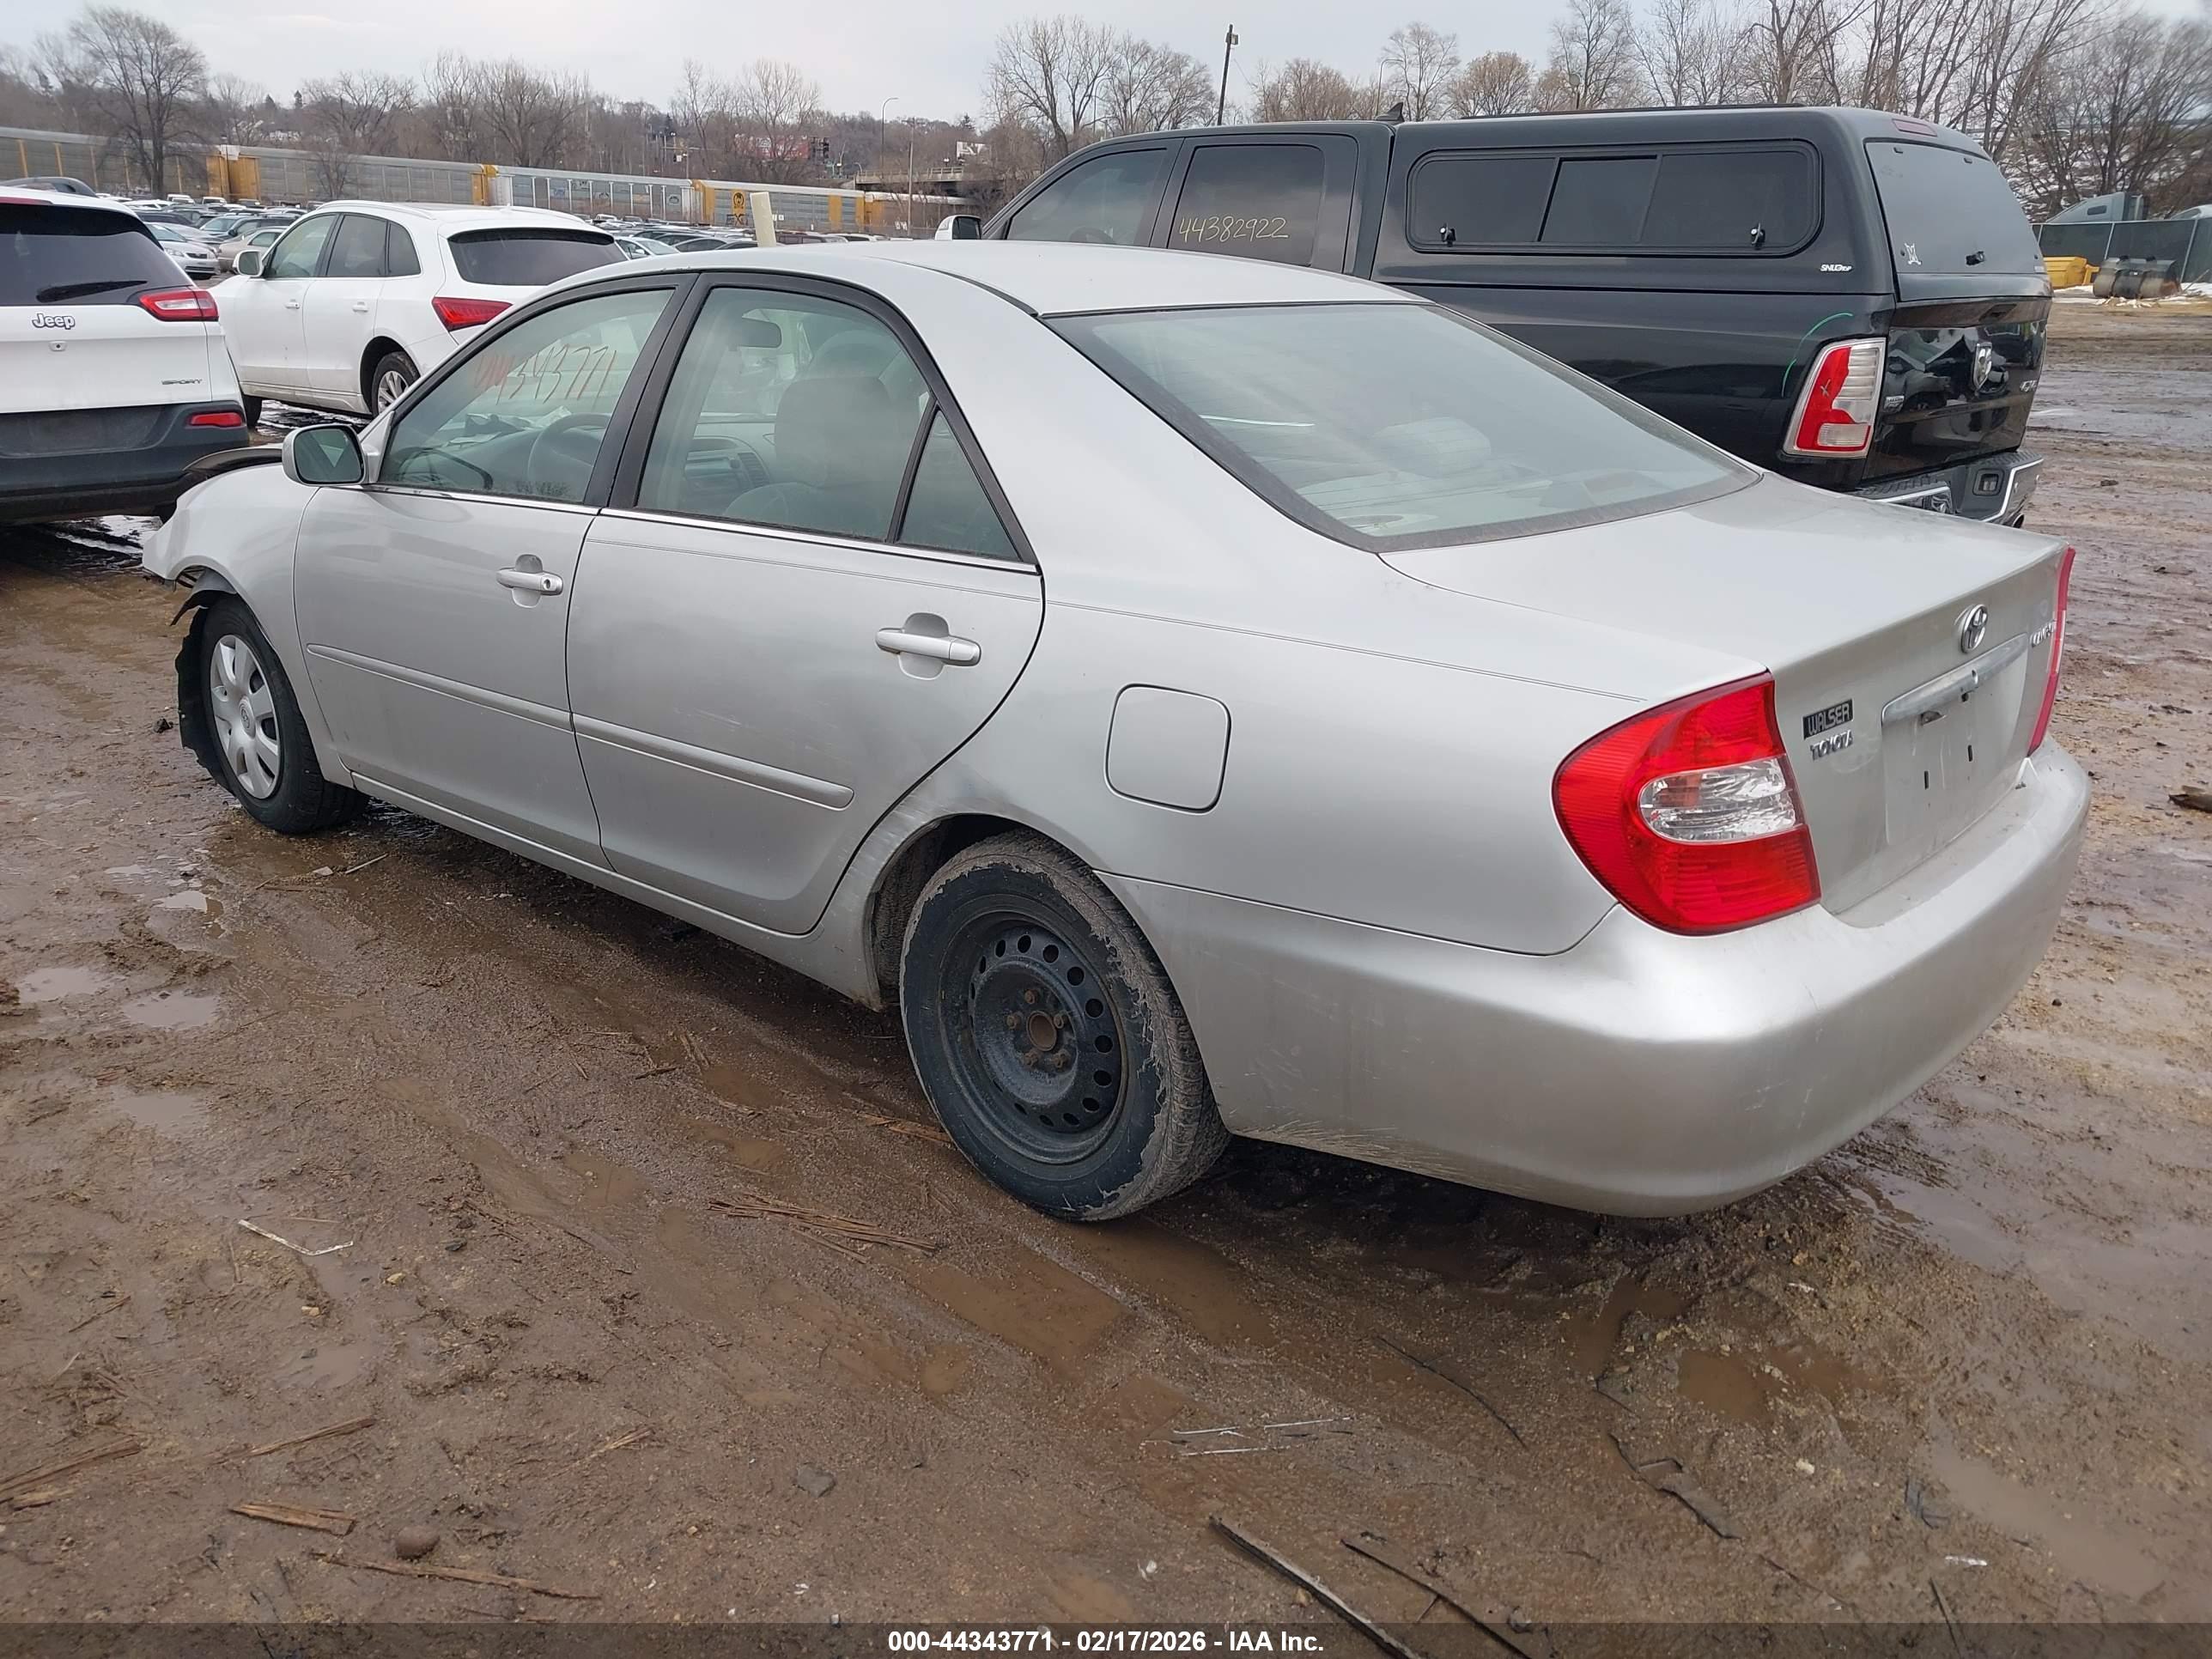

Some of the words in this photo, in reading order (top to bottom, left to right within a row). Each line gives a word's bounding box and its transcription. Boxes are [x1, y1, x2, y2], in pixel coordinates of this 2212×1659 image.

[1179, 216, 1289, 243] 44382922
[32, 313, 76, 330] Jeep
[1807, 702, 1850, 736] WALSER
[1809, 729, 1853, 760] TOYOTA
